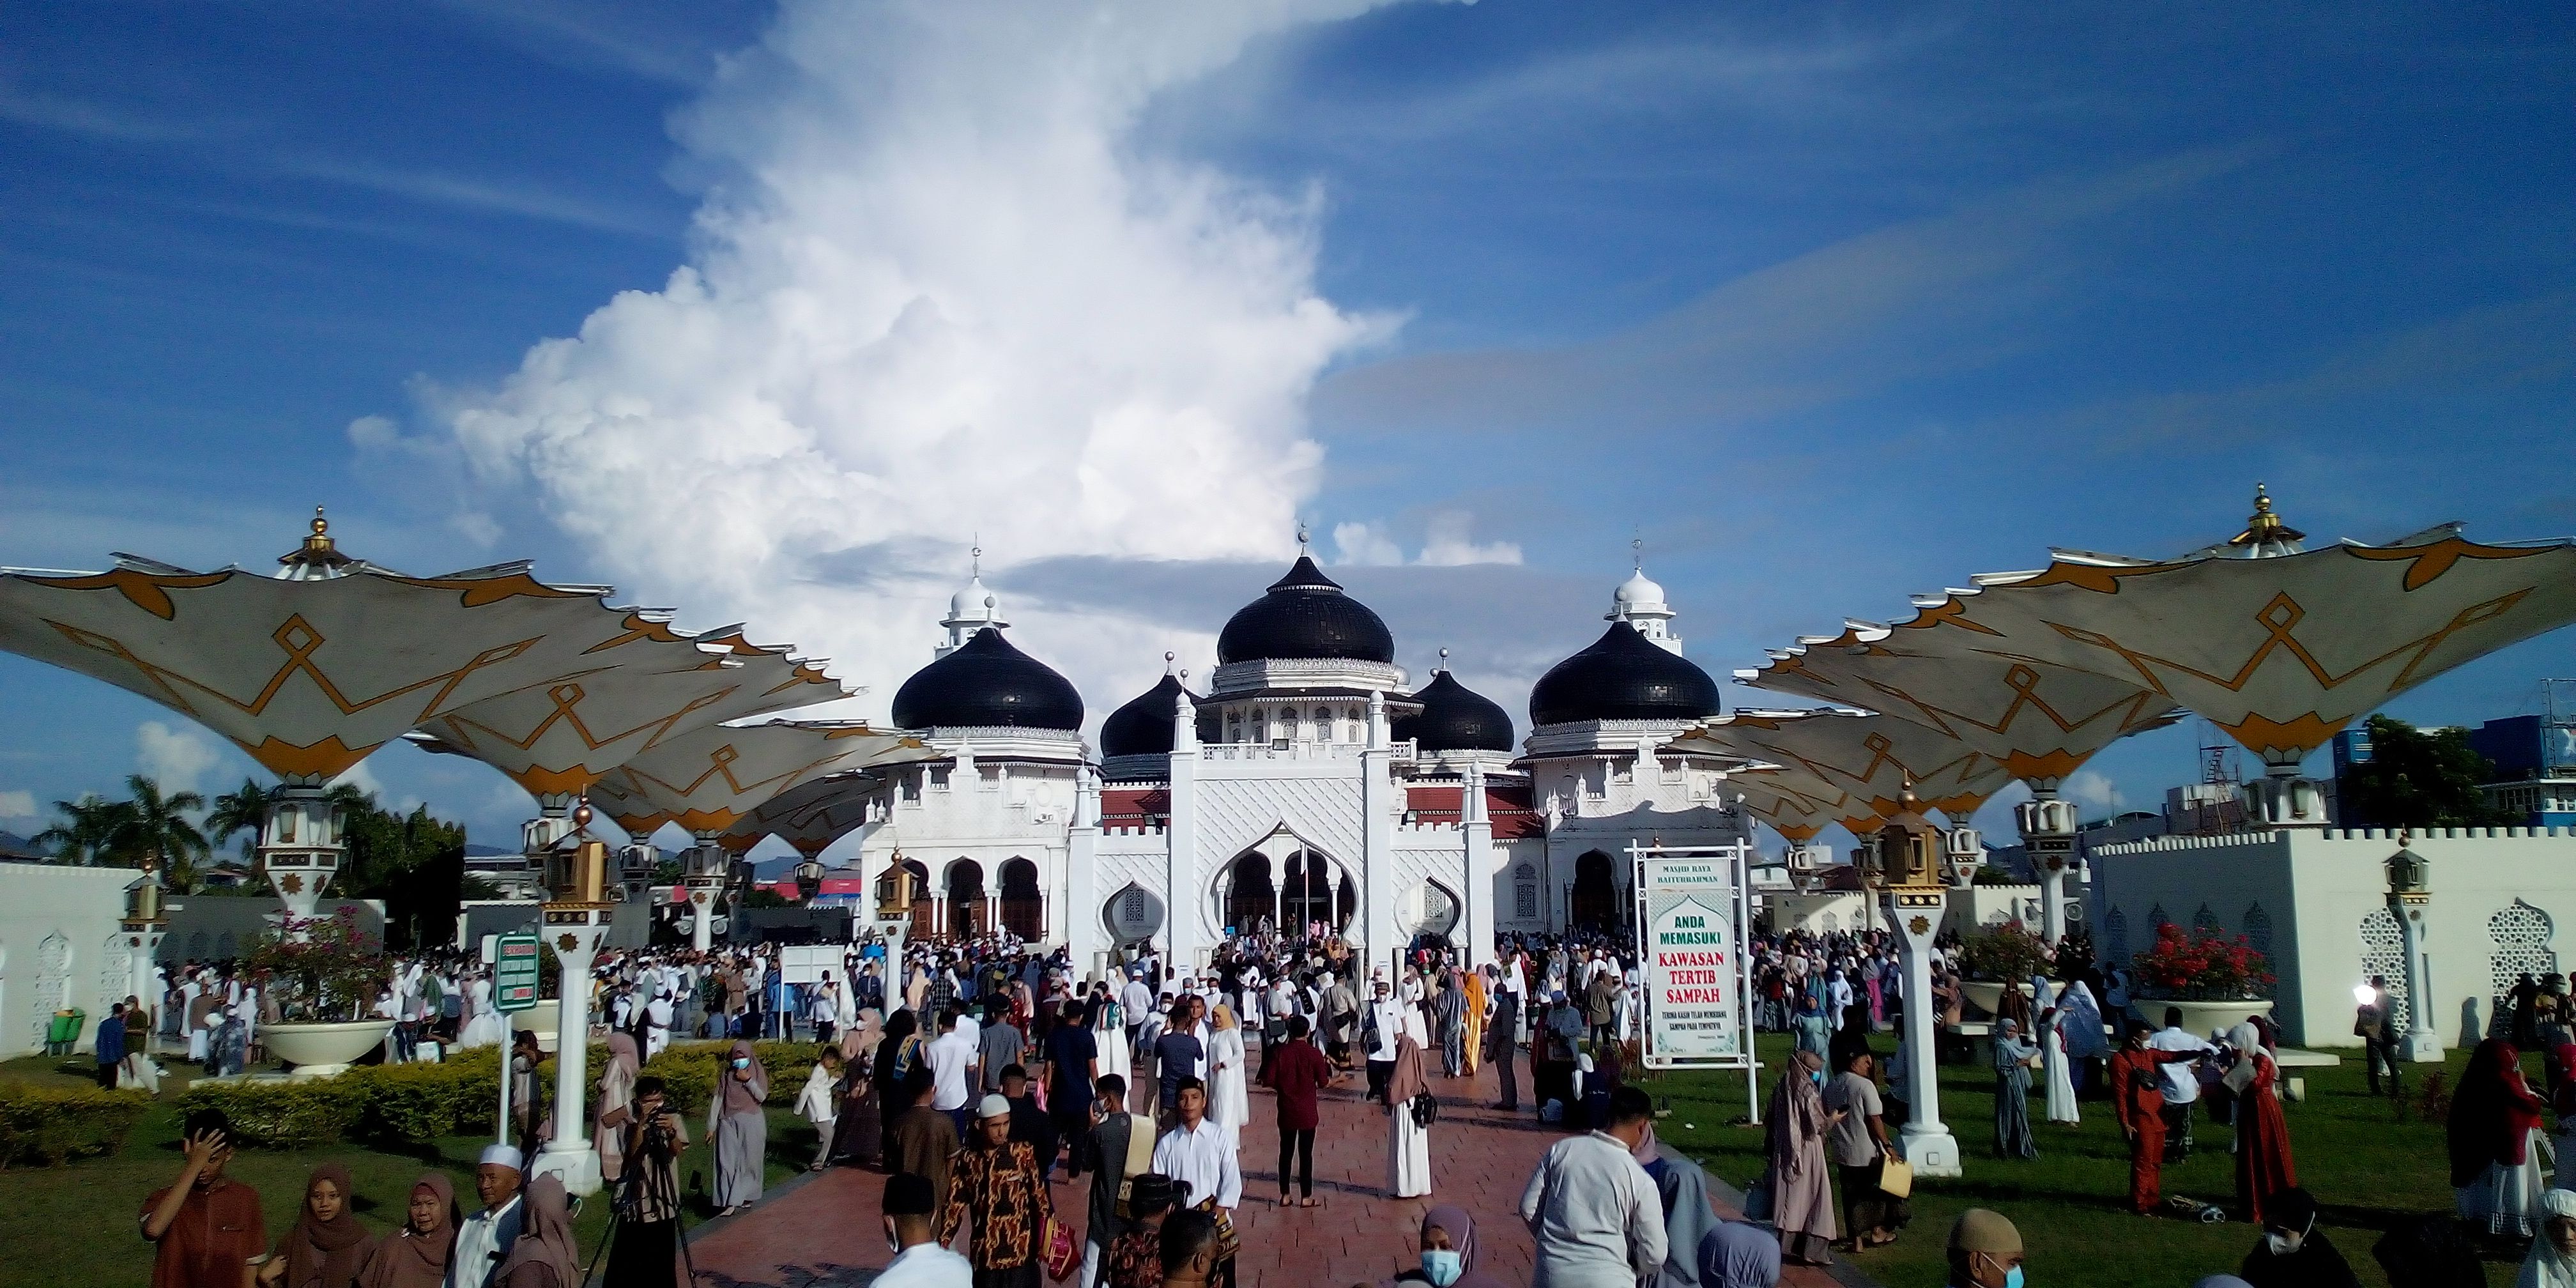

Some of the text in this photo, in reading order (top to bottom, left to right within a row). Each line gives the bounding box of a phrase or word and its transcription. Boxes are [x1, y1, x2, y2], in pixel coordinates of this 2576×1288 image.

[1675, 916, 1706, 928] ANDA
[1660, 931, 1721, 945] MEMASUKI
[1658, 952, 1724, 967] KAWASAN
[1669, 970, 1717, 985] TERTIB
[1666, 988, 1720, 1003] SAMPAH
